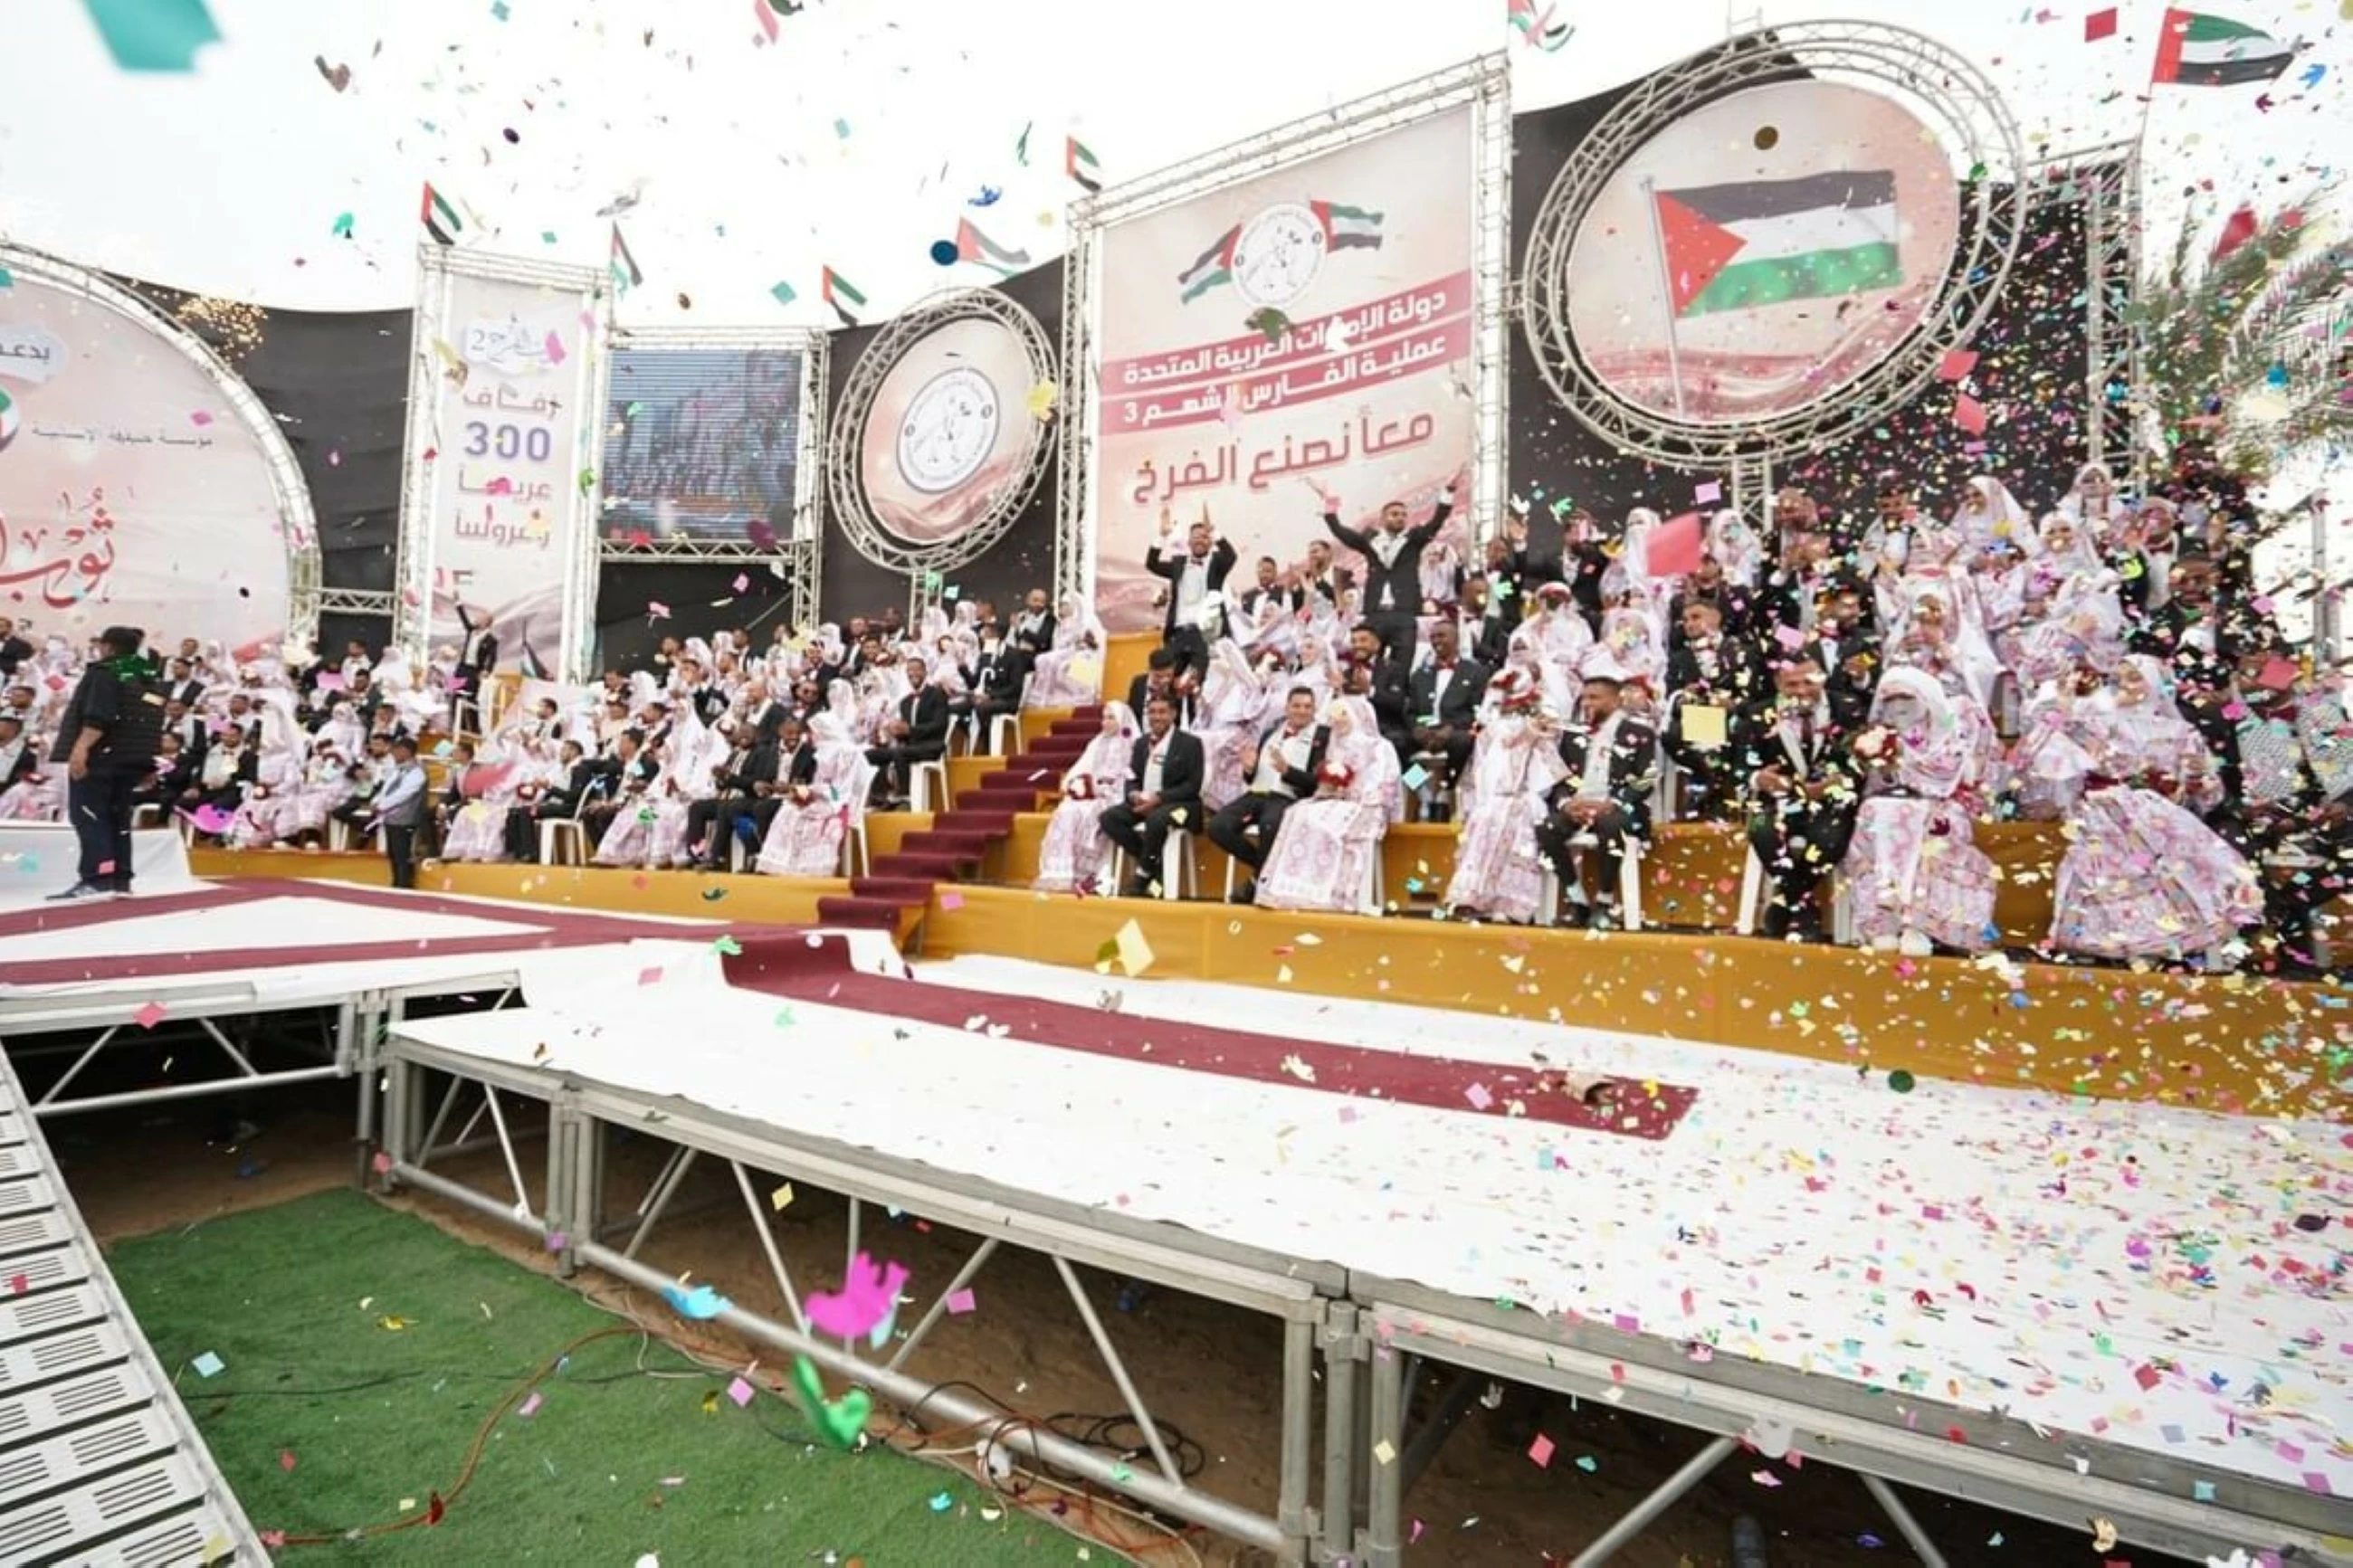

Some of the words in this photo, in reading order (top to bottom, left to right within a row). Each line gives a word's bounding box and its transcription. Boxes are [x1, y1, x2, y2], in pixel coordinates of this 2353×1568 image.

[1296, 304, 1386, 351] الإمات
[1387, 291, 1447, 324] دولة
[0, 344, 50, 364] بدع
[1124, 349, 1213, 385] المتحدة
[1215, 324, 1293, 373] العربية
[1360, 335, 1447, 376] عملية
[1243, 355, 1358, 413] الفارس
[1124, 401, 1138, 424] 3
[463, 420, 552, 462] 300
[1248, 421, 1350, 490] نصنع
[1134, 445, 1236, 504] الفرح
